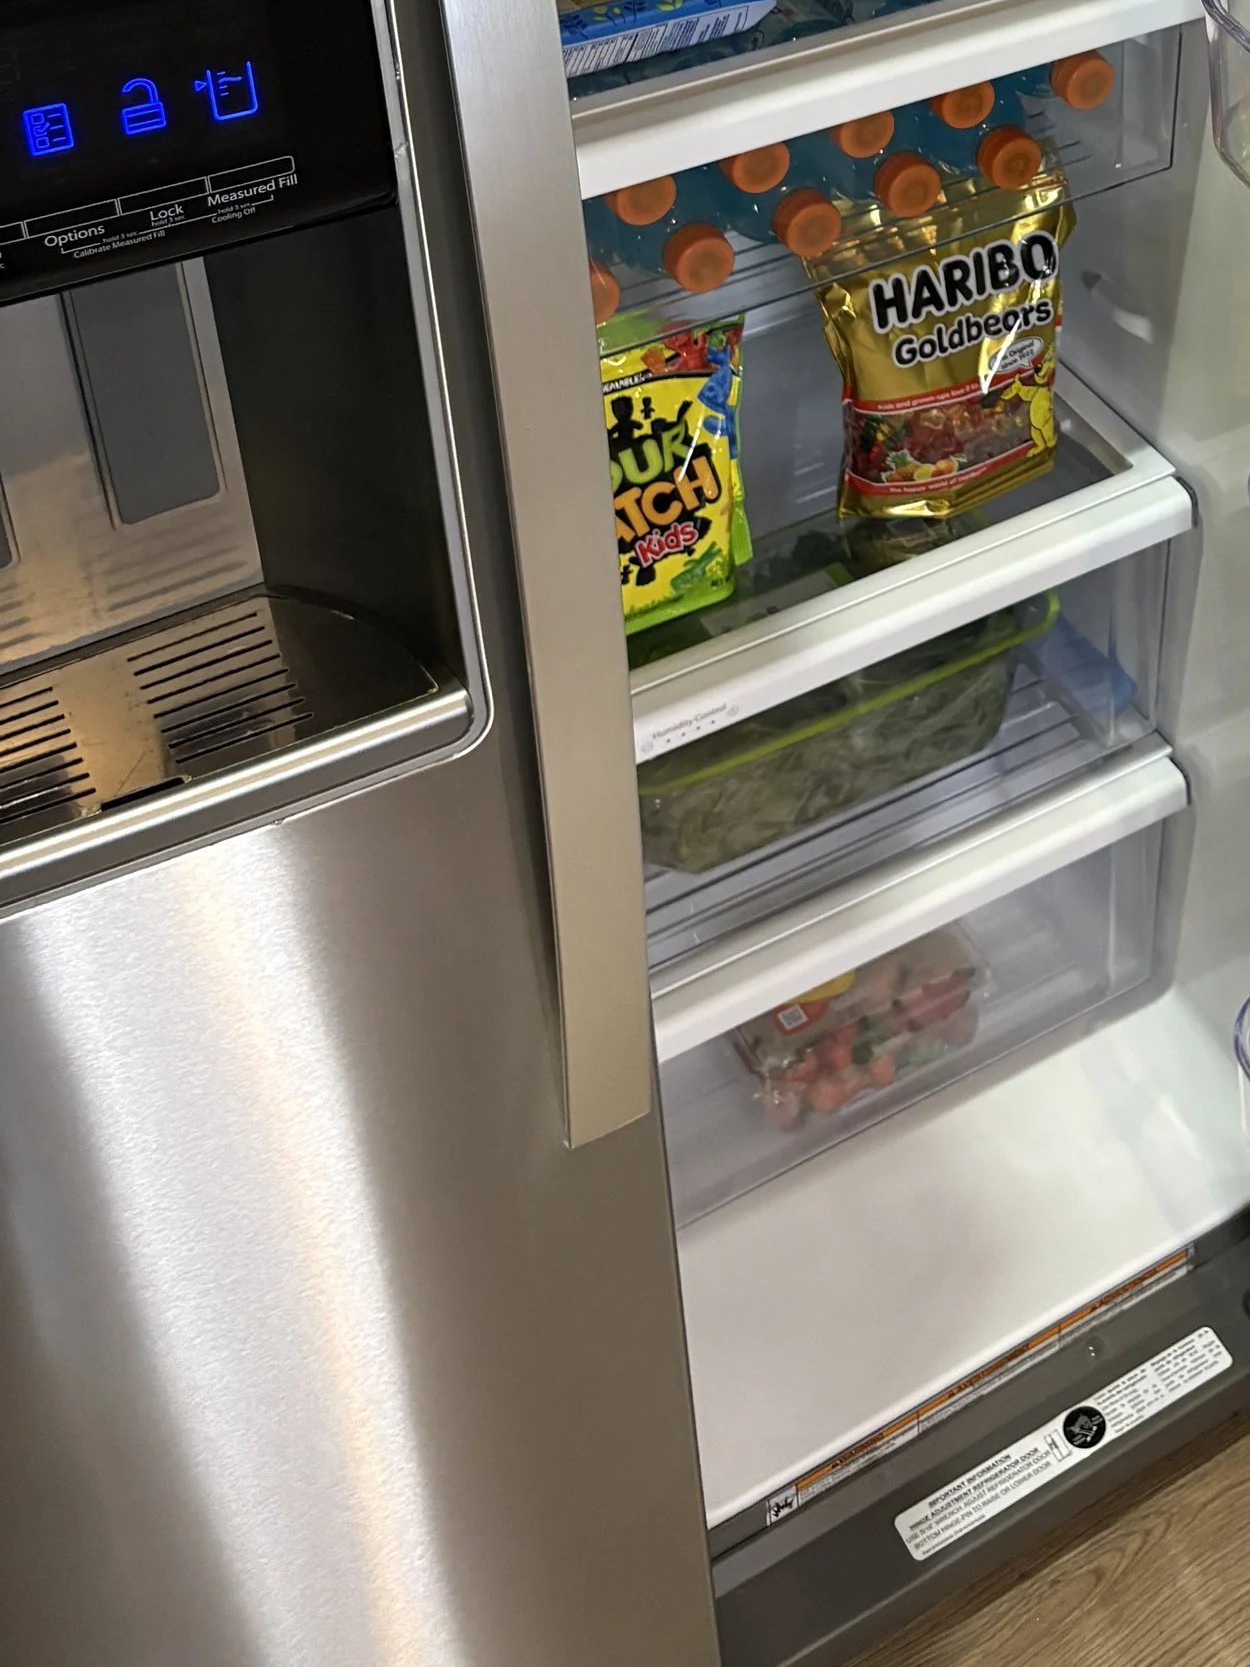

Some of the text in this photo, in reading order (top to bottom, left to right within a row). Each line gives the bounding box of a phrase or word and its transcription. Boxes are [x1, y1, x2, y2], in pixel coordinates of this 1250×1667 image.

[207, 174, 298, 207] Measured Fill
[150, 204, 185, 221] Lock
[151, 218, 168, 226] hold
[211, 207, 256, 224] Cooling Off
[44, 224, 106, 248] Options
[73, 230, 166, 259] Calibrate Measured Fill
[871, 232, 1058, 331] HARIBO
[895, 301, 1052, 365] Goldbears
[636, 522, 698, 567] Kids
[653, 702, 727, 739] Humidity Control
[928, 1454, 1012, 1509] IMPORTANT INFORMATION
